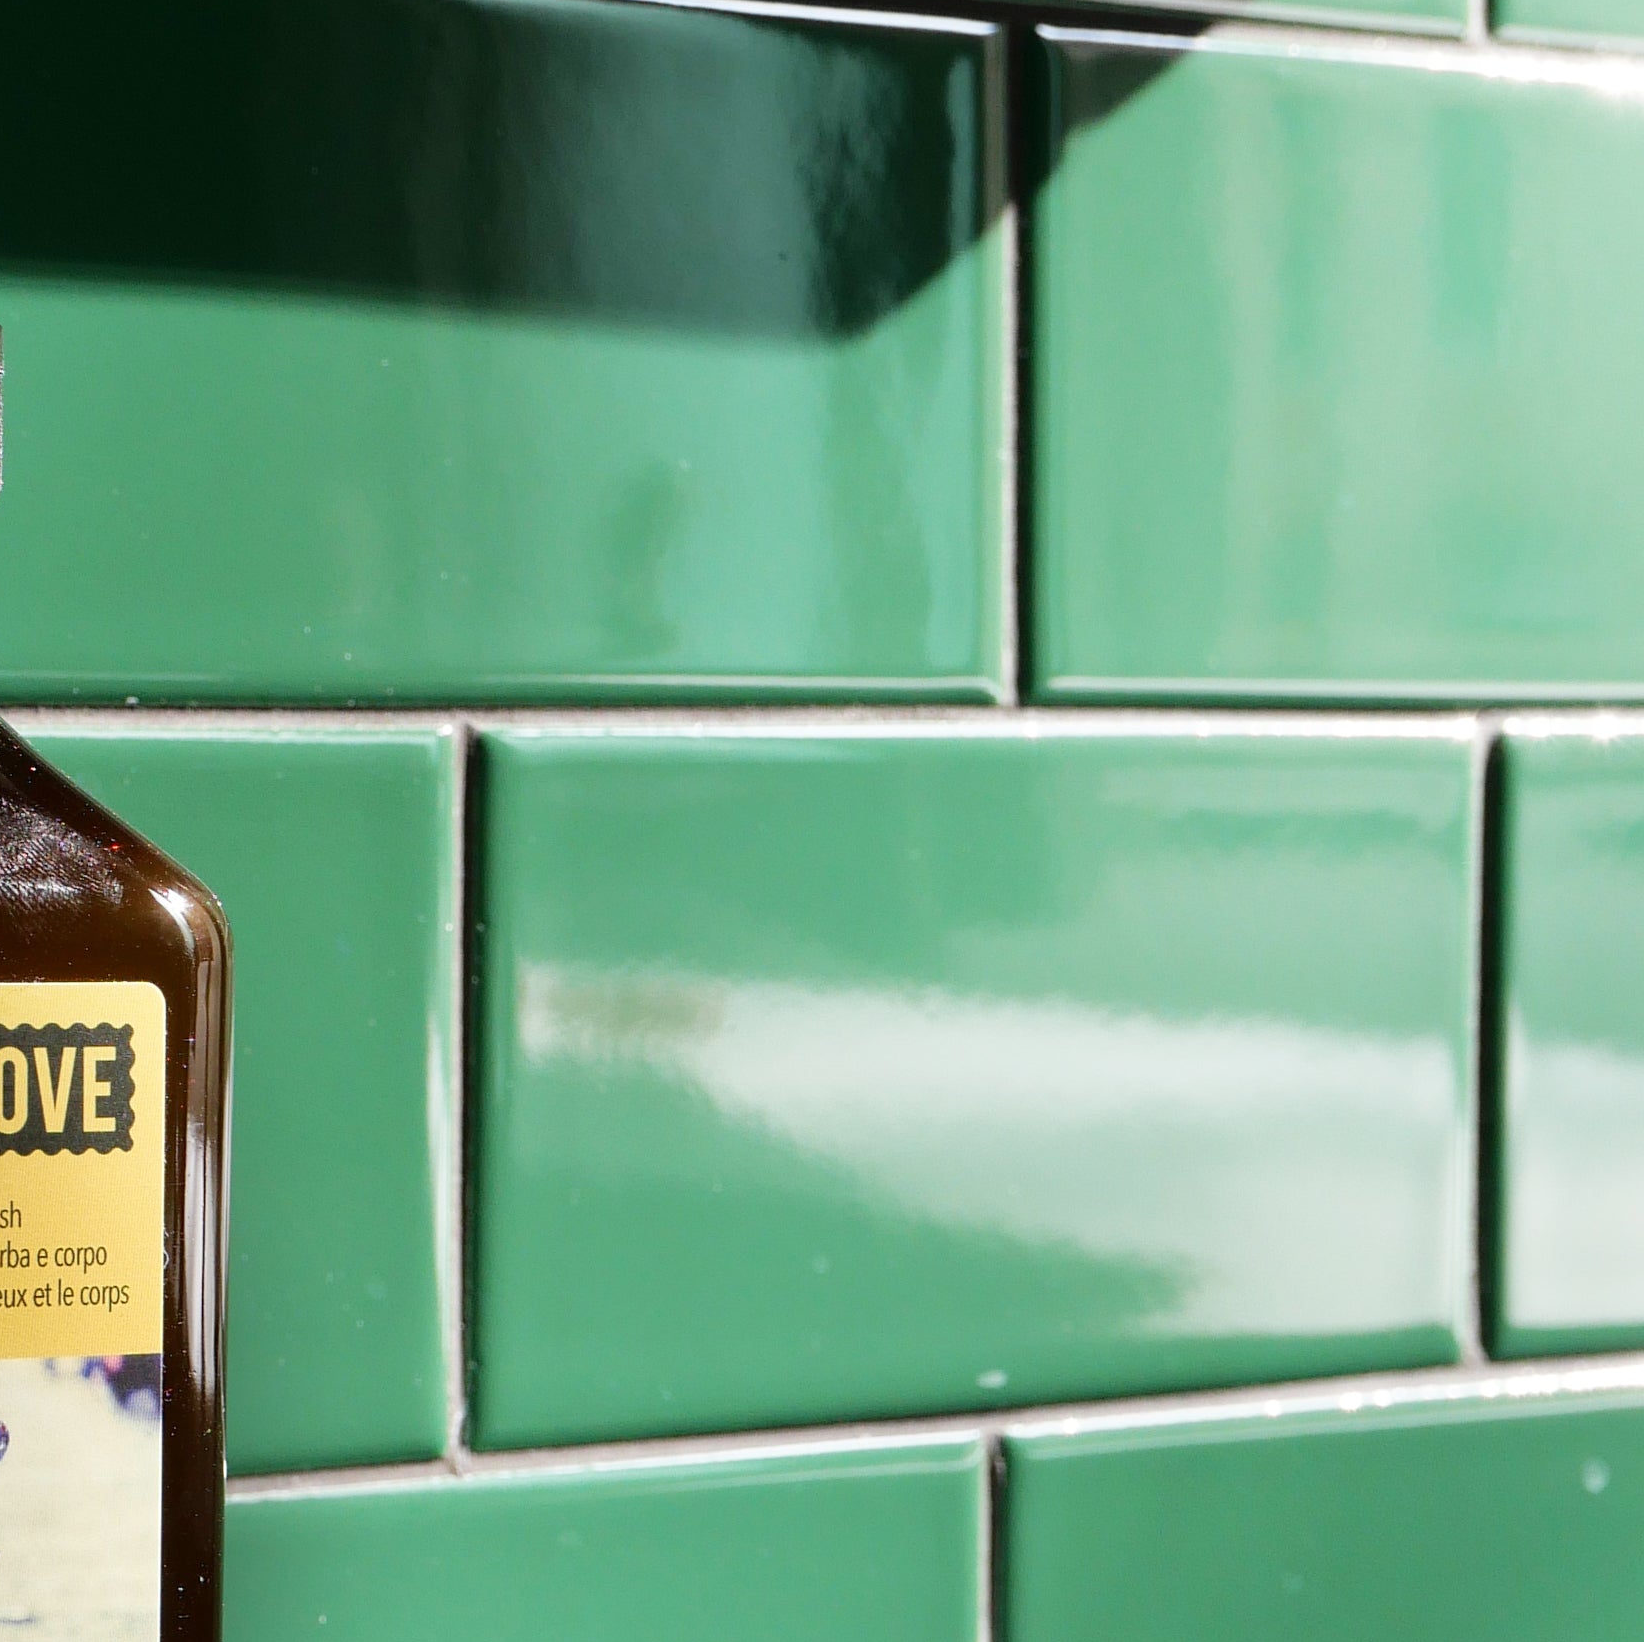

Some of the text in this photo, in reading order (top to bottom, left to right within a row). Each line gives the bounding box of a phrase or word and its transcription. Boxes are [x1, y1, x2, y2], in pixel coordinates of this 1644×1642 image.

[37, 1249, 48, 1269] e
[54, 1244, 107, 1274] corpo
[33, 1284, 52, 1308] et
[58, 1282, 74, 1307] le
[80, 1282, 130, 1312] corps
